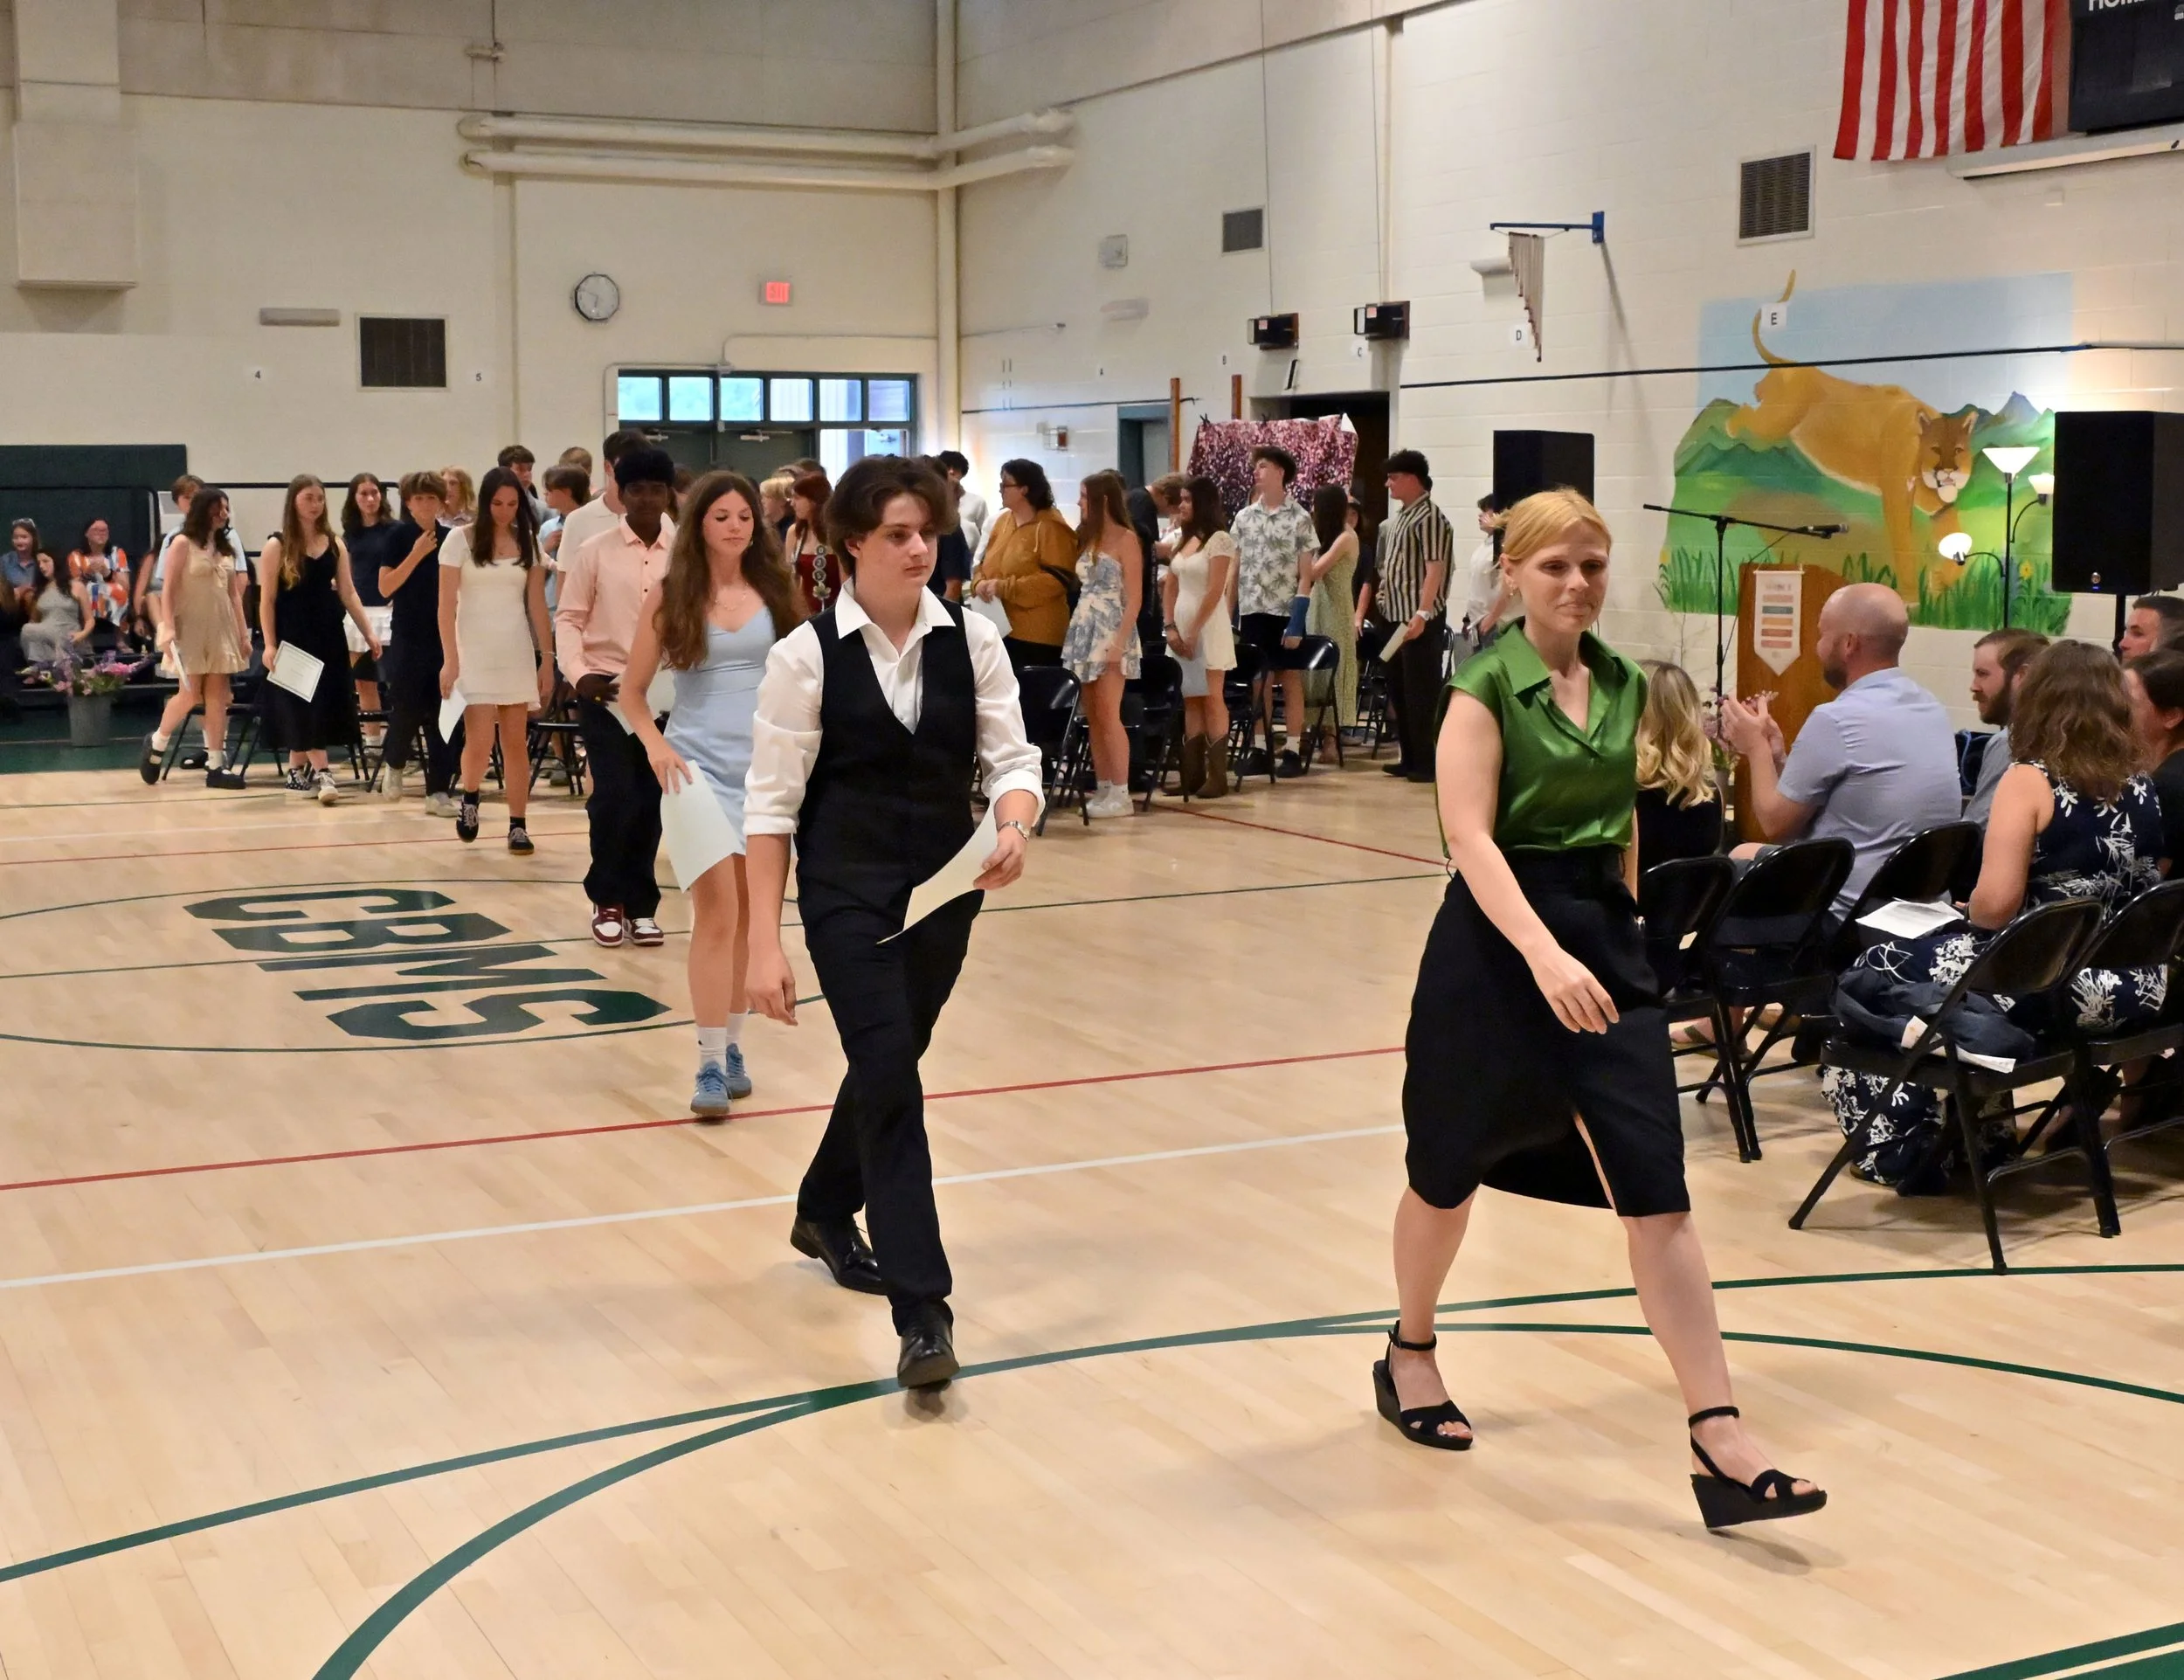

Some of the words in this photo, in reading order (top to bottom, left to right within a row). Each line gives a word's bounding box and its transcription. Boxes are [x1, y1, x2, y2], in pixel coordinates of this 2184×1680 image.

[1771, 312, 1778, 325] E
[1516, 329, 1522, 341] D
[1358, 347, 1362, 356] C
[255, 370, 261, 379] 4
[475, 373, 482, 382] 5
[183, 888, 672, 1040] CBMS
